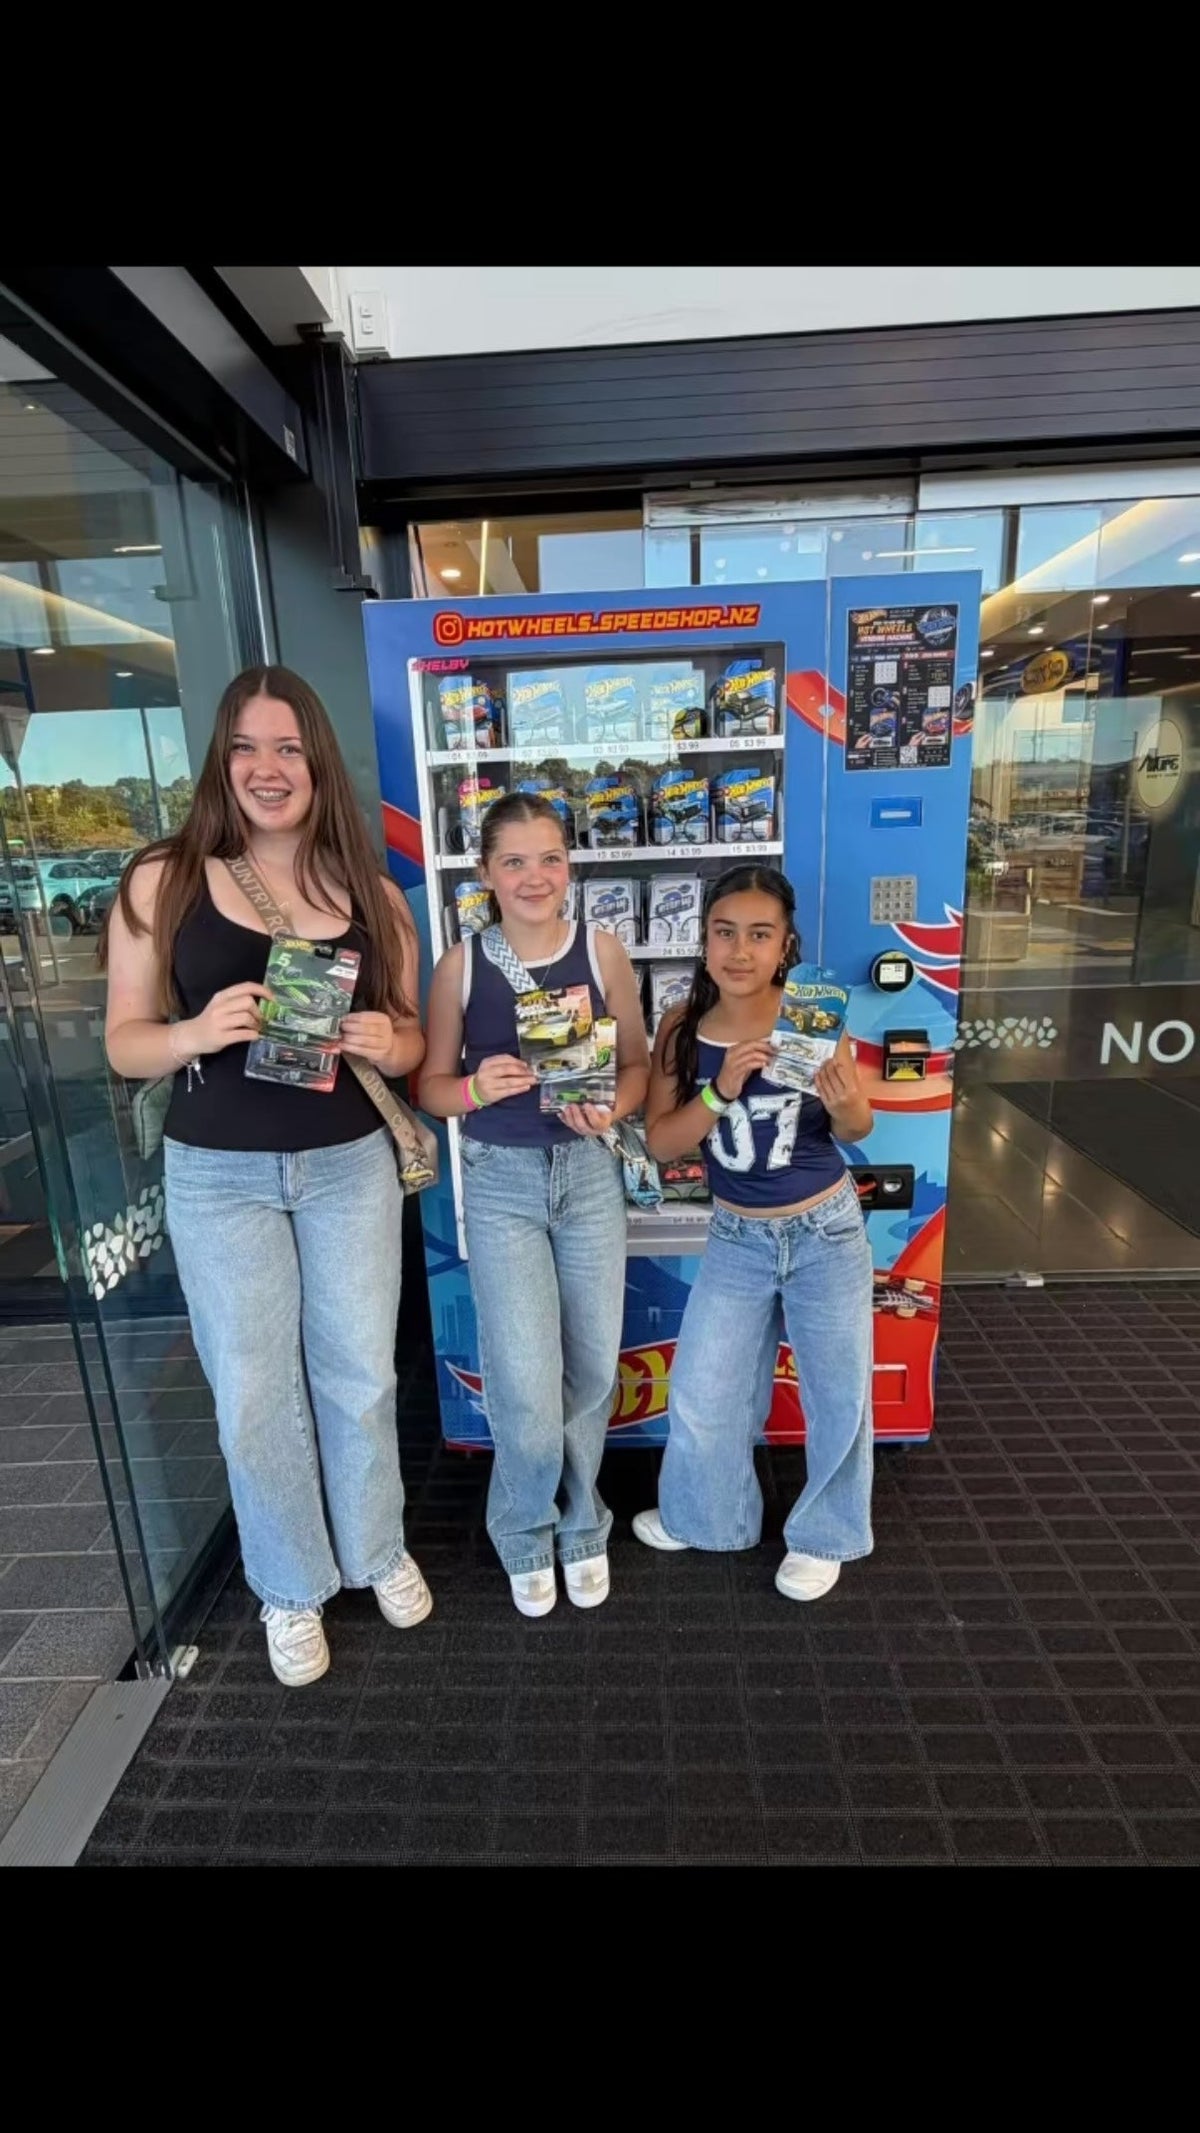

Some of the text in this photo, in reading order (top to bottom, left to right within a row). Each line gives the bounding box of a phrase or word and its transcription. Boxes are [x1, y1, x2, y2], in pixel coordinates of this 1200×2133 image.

[468, 605, 758, 638] HOTWHEELS_SPEEDSHOP_NZ
[226, 856, 277, 911] UNTRY
[1100, 1019, 1195, 1065] NO
[358, 1064, 386, 1102] OAD
[706, 1092, 802, 1173] 07
